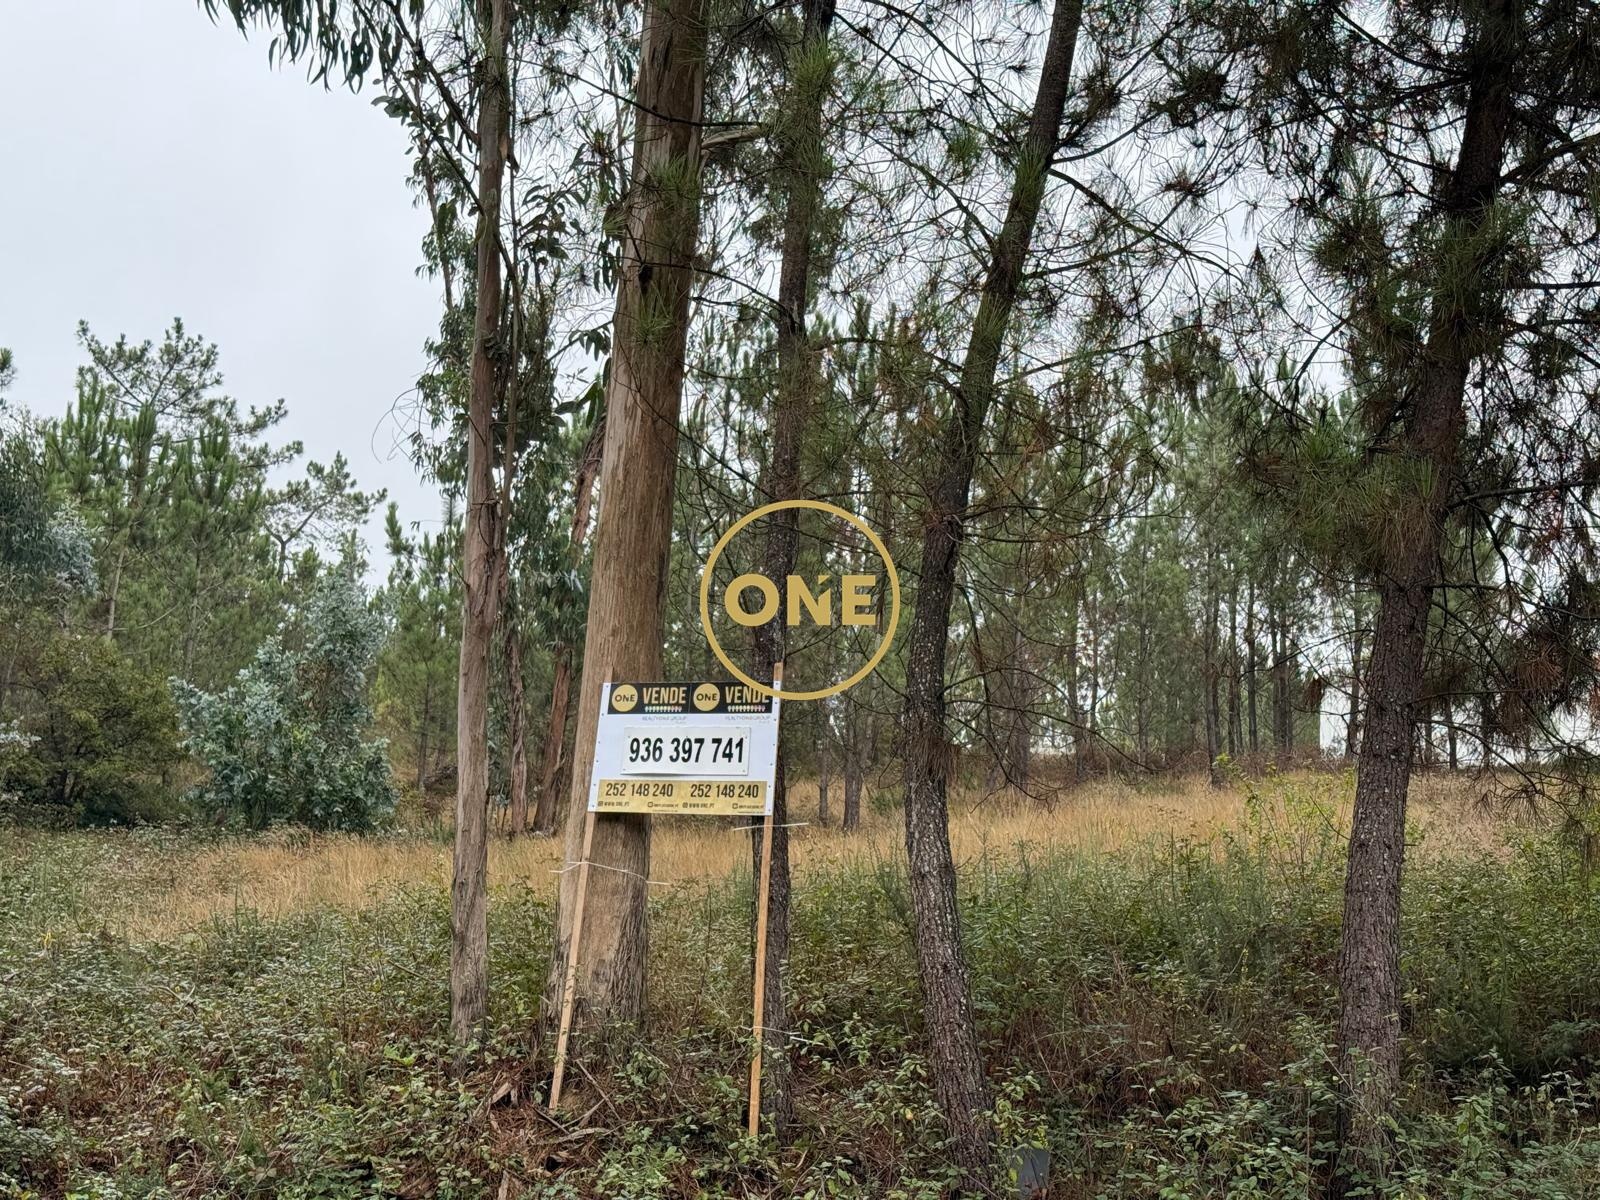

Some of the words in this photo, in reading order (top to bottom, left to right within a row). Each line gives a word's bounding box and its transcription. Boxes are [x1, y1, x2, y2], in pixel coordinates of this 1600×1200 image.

[614, 694, 636, 703] ONE
[642, 687, 688, 704] VENDE
[696, 693, 718, 702] ONE
[629, 737, 664, 763] 936
[669, 737, 705, 763] 397
[711, 737, 745, 763] 741
[605, 782, 627, 797] 252
[630, 783, 650, 797] 148
[652, 783, 674, 797] 240
[690, 783, 712, 798] 252
[716, 784, 736, 798] 148
[737, 784, 760, 799] 240
